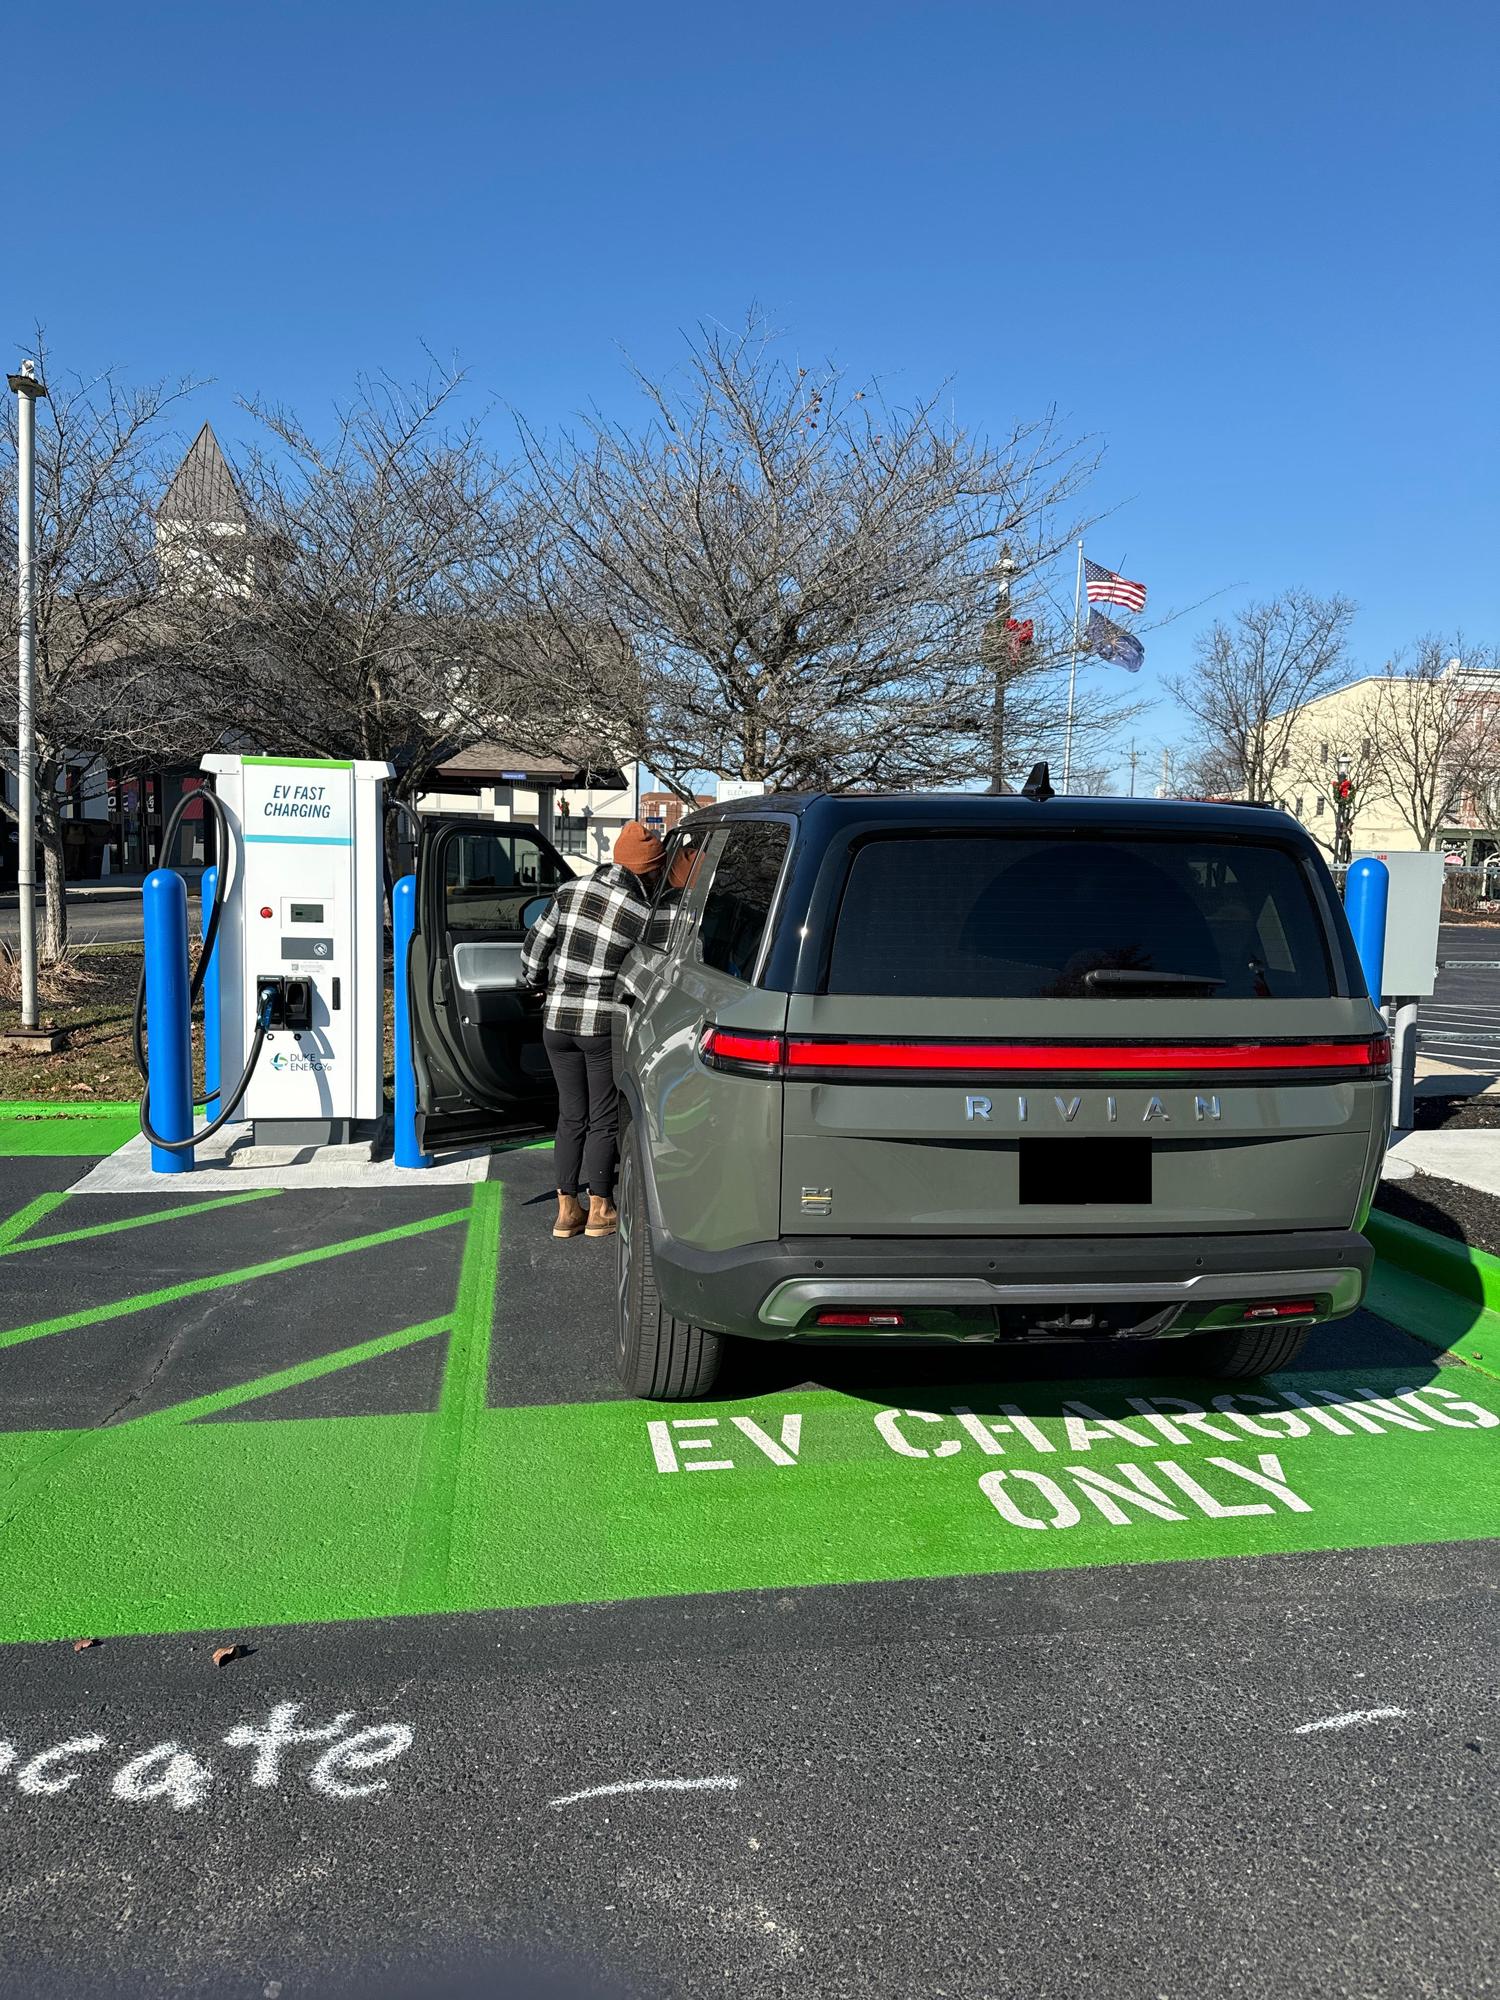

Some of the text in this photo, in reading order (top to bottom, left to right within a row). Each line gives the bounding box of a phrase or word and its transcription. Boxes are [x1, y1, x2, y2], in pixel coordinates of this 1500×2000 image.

[273, 785, 326, 801] EV FAST
[264, 802, 331, 818] CHARGING
[290, 1053, 316, 1062] DUKE
[290, 1062, 328, 1072] ENERGY
[965, 1096, 1222, 1122] RIVIAN
[646, 1386, 1500, 1474] EV CHARGING
[978, 1454, 1314, 1530] ONLY
[0, 1702, 416, 1808] cate
